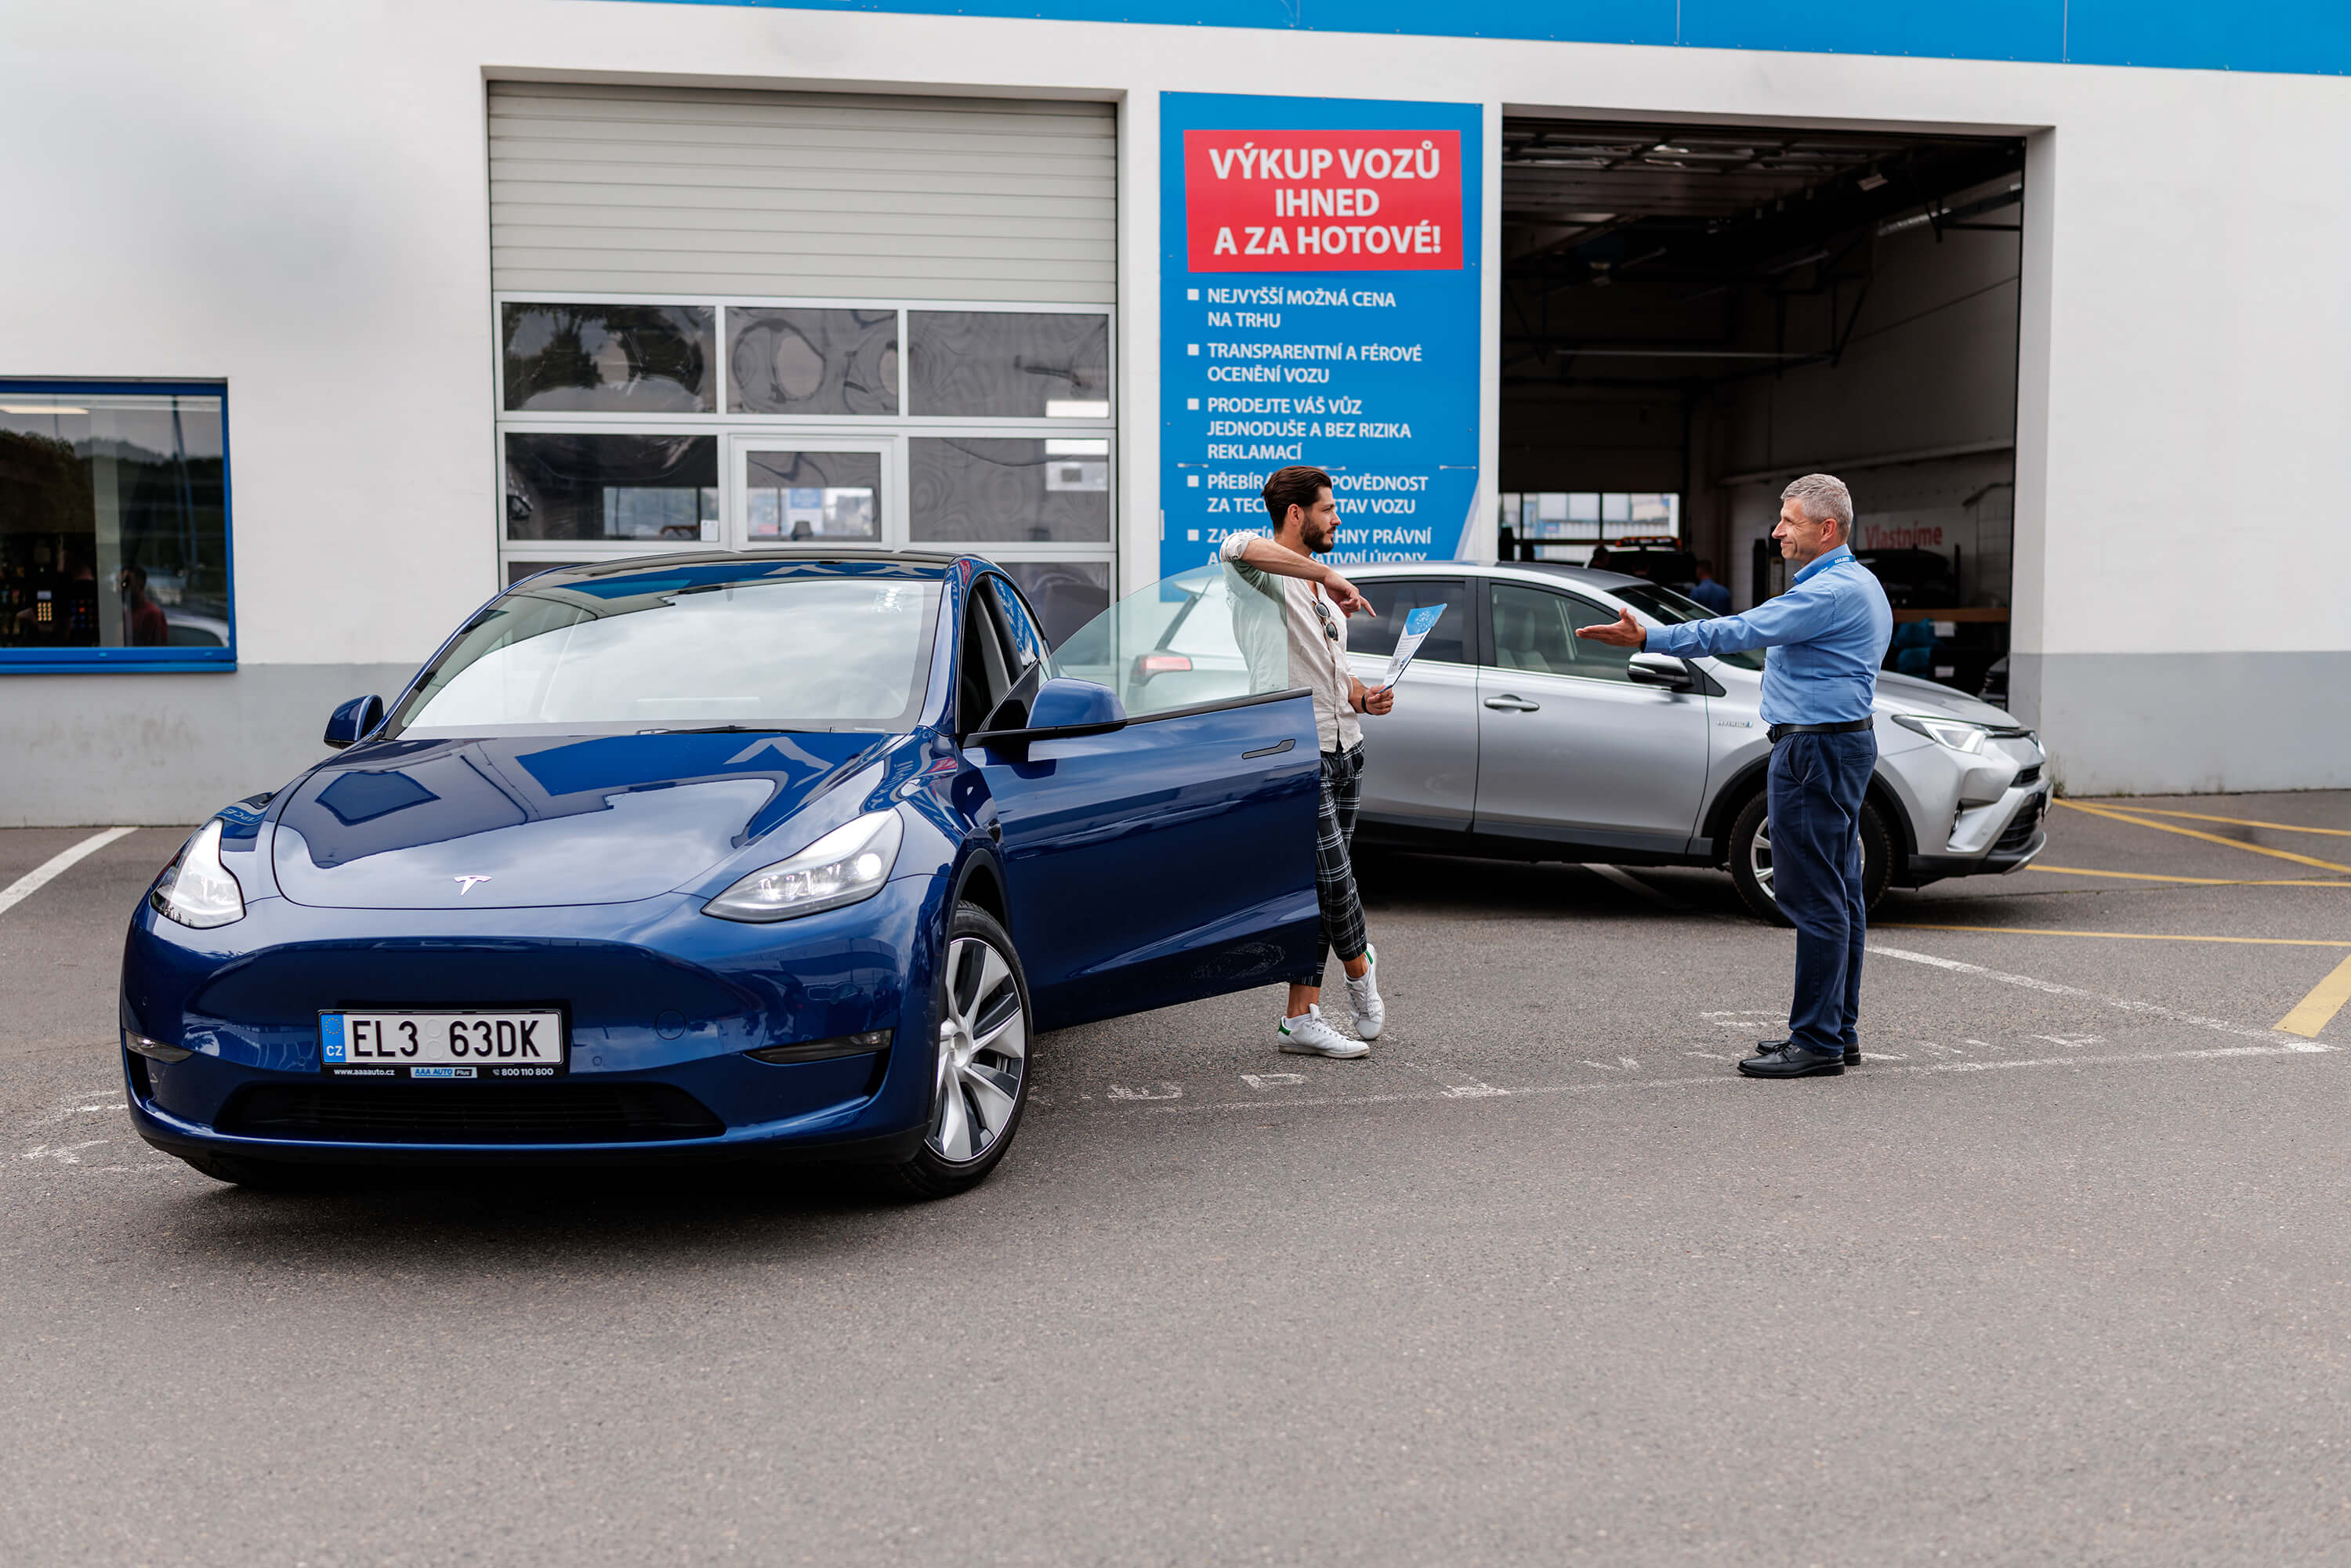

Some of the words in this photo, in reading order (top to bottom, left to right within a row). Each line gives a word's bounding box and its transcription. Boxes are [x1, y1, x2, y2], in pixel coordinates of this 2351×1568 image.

[1208, 142, 1333, 179] VÝKUP
[1338, 139, 1440, 179] VOZŮ
[1275, 188, 1380, 217] IHNED
[1213, 227, 1238, 255] A
[1244, 226, 1291, 255] ZA
[1298, 219, 1442, 255] HOTOVÉ!
[1208, 287, 1284, 305] NEJVYŠŠÍ
[1287, 288, 1349, 306] MOŽNÁ
[1352, 292, 1396, 307] CENA
[1208, 312, 1233, 327] NA
[1235, 313, 1281, 328] TRHU
[1208, 342, 1343, 360] TRANSPARENTNÍ
[1346, 346, 1357, 360] A
[1361, 343, 1422, 362] FÉROVÉ
[1208, 364, 1281, 382] OCENĚNÍ
[1284, 368, 1330, 383] VOZU
[1208, 397, 1291, 414] PRODEJTE
[1294, 397, 1325, 415] VÁŠ
[1328, 396, 1363, 415] VŮZ
[1207, 419, 1306, 437] JEDNODUŠE
[1310, 422, 1322, 437] A
[1325, 422, 1356, 438] BEZ
[1359, 423, 1411, 438] RIZIKA
[1208, 442, 1302, 460] REKLAMACÍ
[1208, 472, 1273, 490] PŘEBÍR
[1330, 473, 1429, 491] POVĚDNOST
[1207, 498, 1230, 512] ZA
[1371, 499, 1416, 514] VOZU
[1373, 527, 1433, 545] PRÁVNÍ
[352, 1020, 419, 1057] EL3
[449, 1020, 542, 1057] 63DK
[326, 1045, 343, 1056] CZ
[502, 1067, 520, 1077] 800
[520, 1067, 534, 1077] 110
[535, 1067, 554, 1077] 800
